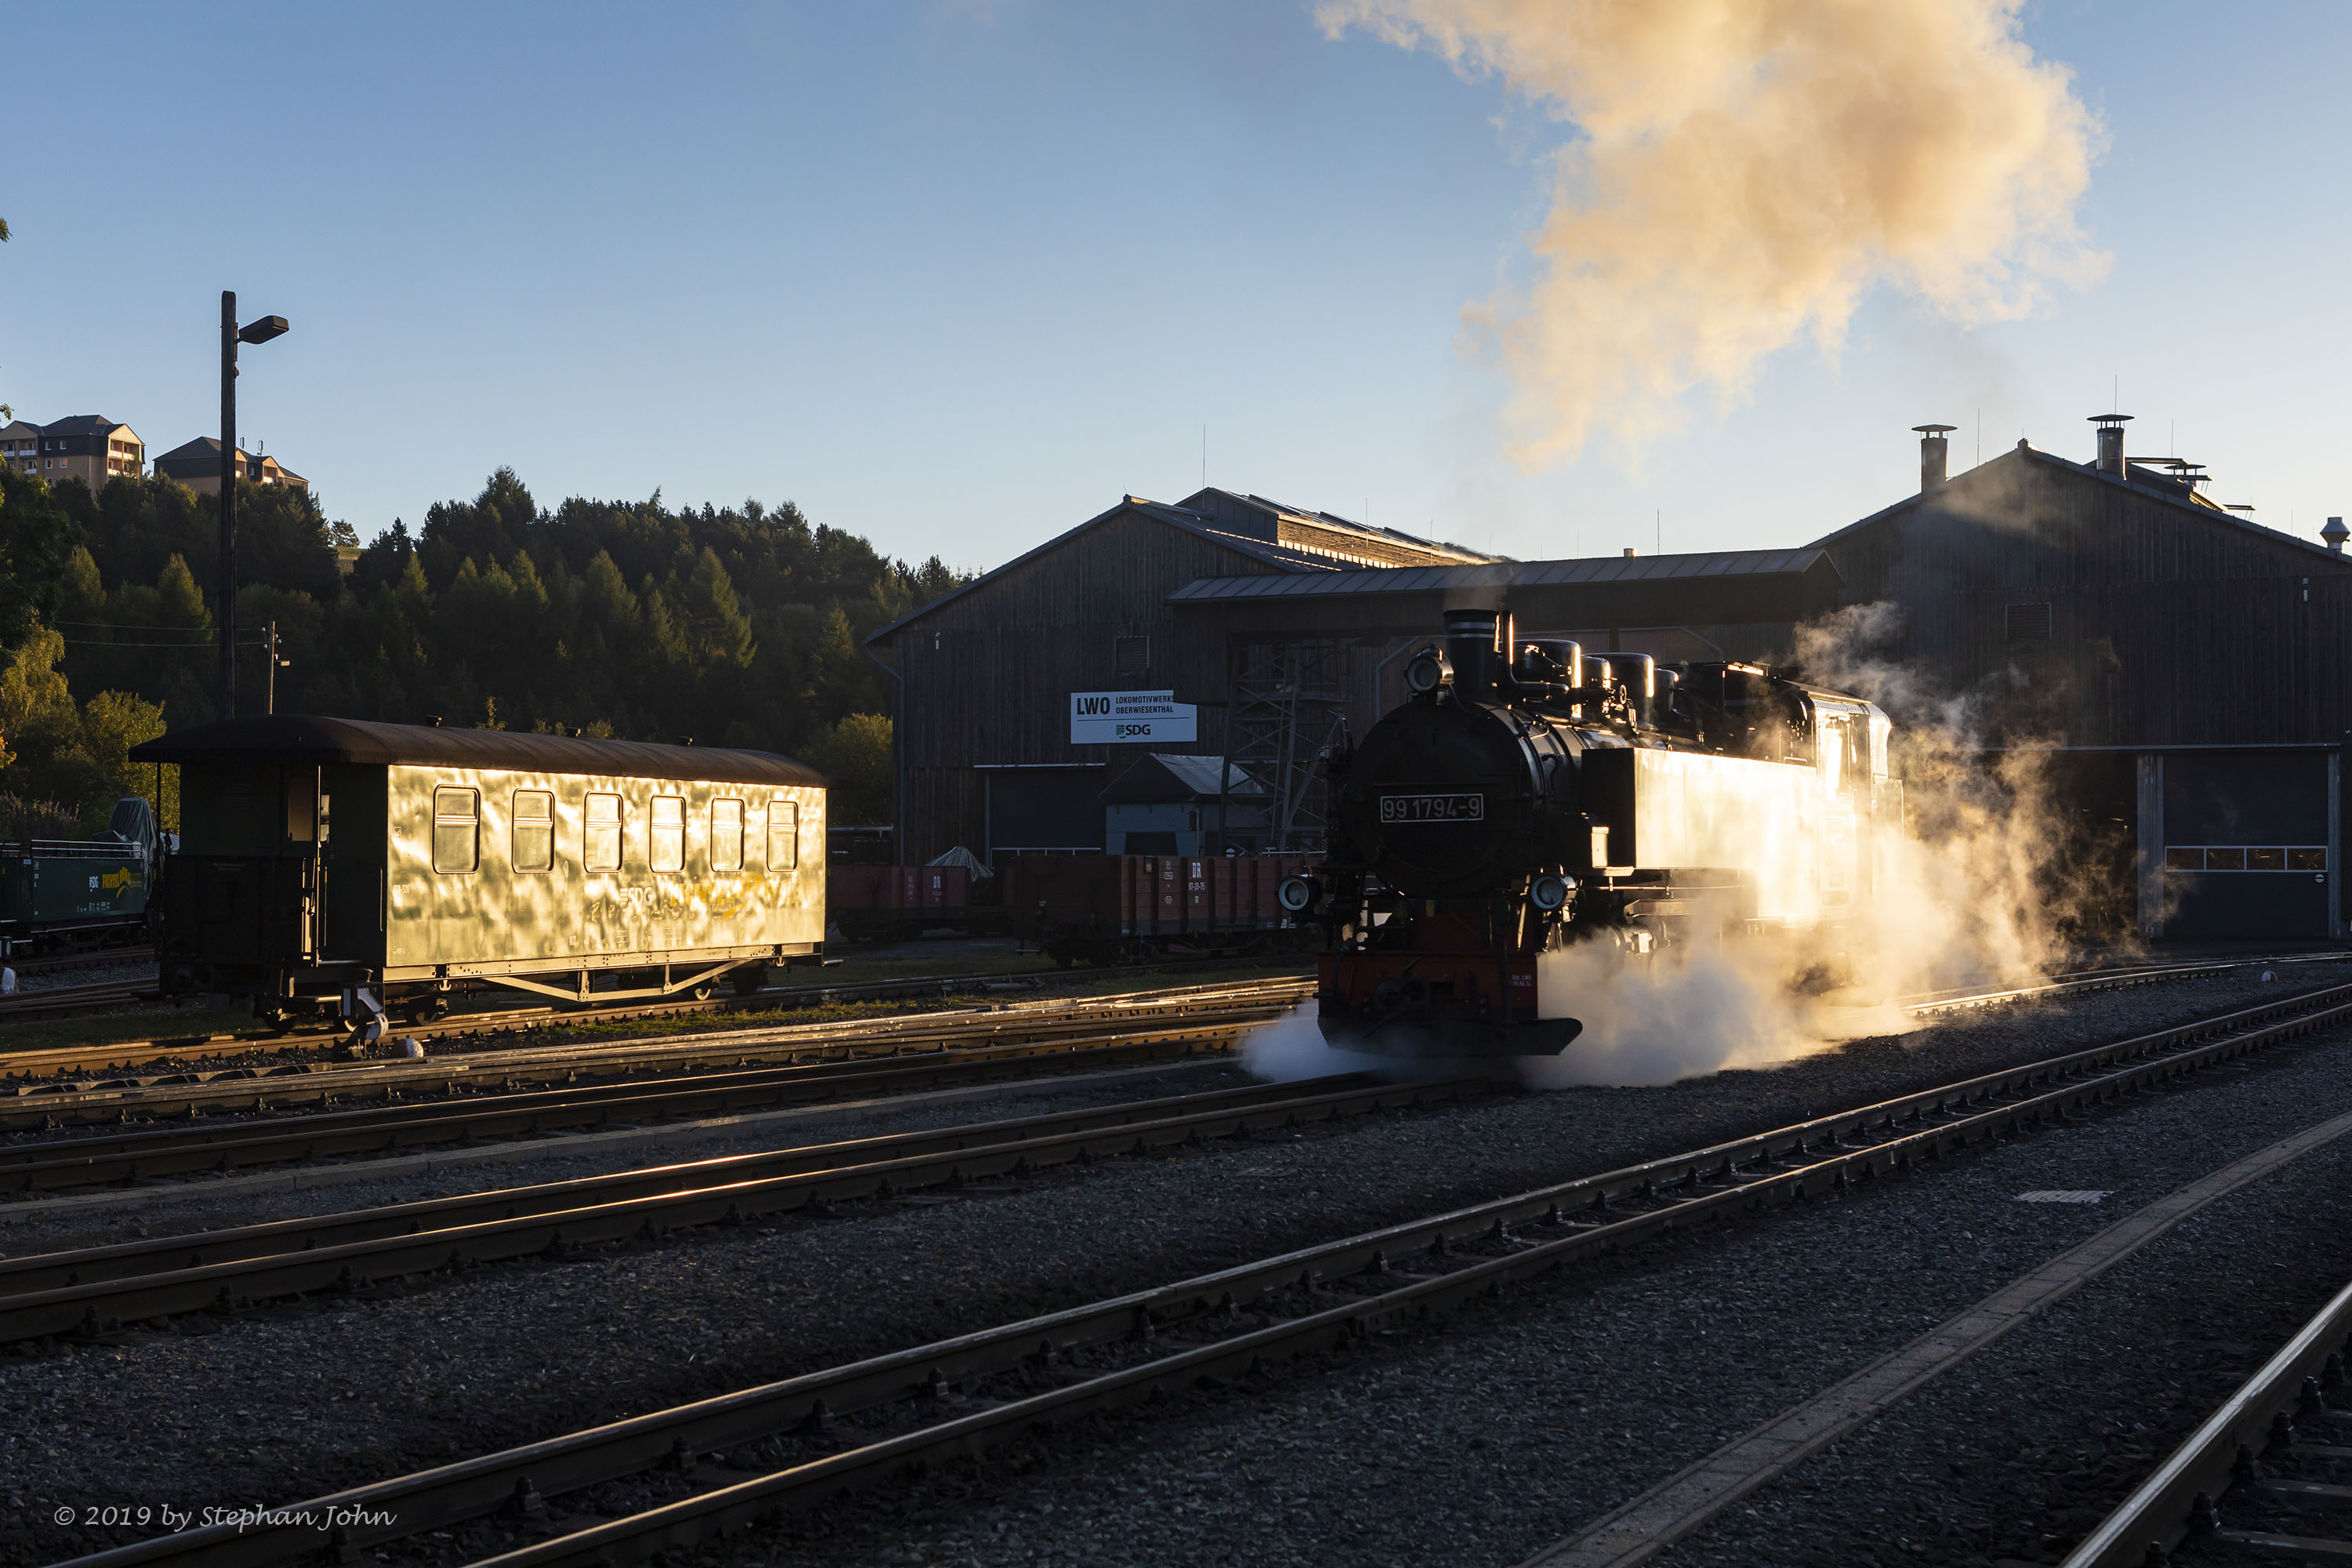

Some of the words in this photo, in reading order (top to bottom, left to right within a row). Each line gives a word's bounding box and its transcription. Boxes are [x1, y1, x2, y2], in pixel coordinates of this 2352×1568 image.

[1076, 696, 1110, 715] LWO
[1116, 706, 1174, 714] OBERWIESENTHAL
[1125, 724, 1151, 735] SDG
[1384, 800, 1407, 818] 99
[1412, 797, 1480, 818] 1794-9
[1192, 862, 1202, 878] DR
